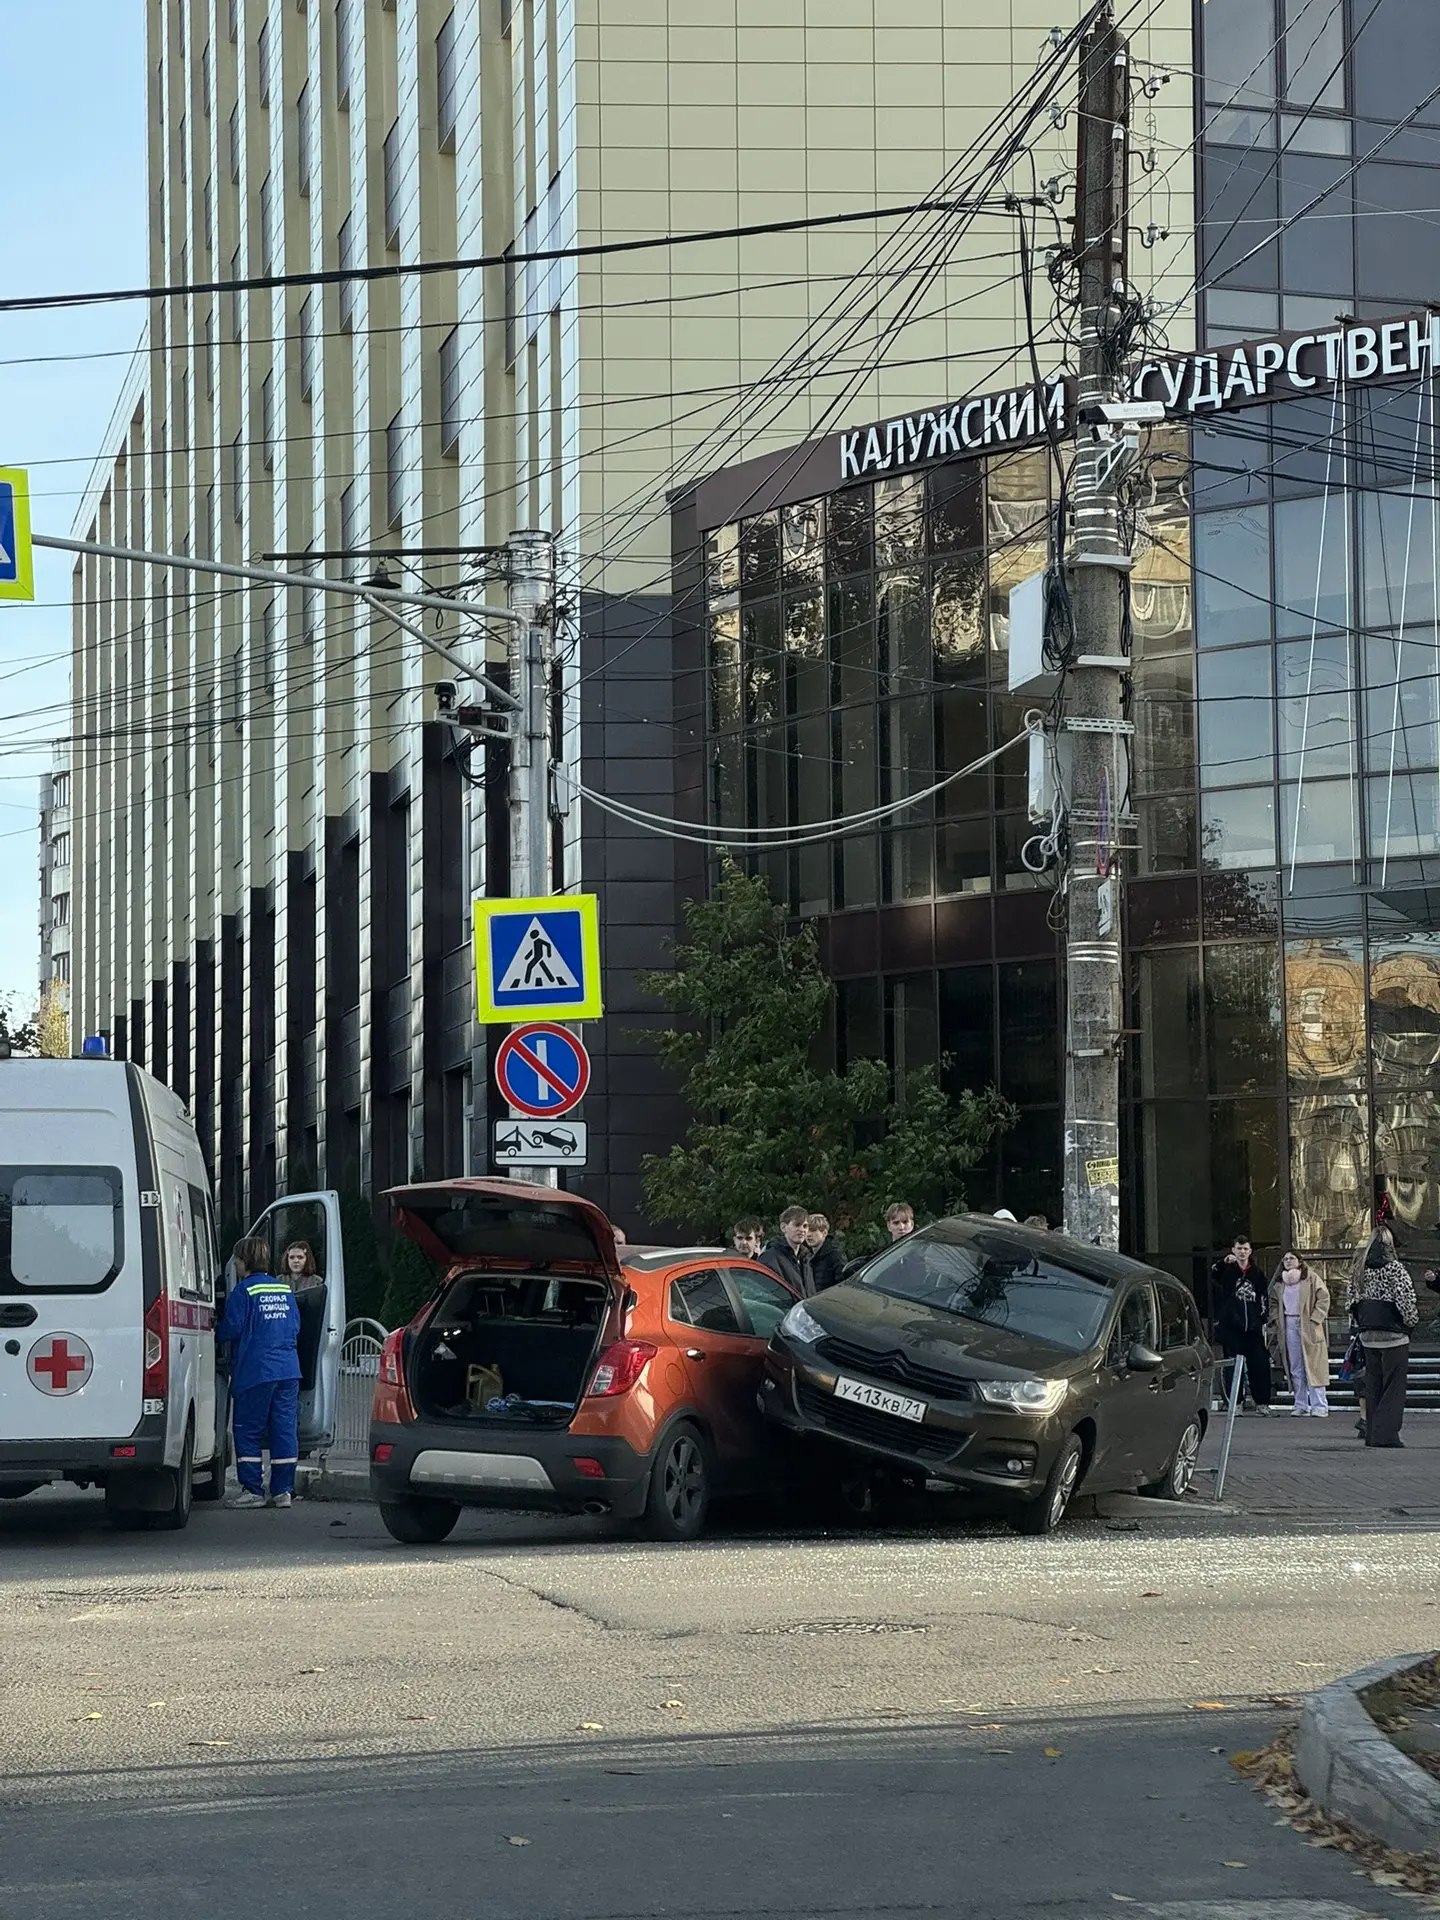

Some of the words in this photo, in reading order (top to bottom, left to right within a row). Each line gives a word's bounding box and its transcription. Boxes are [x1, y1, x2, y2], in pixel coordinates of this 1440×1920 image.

[840, 374, 1065, 479] КАЛУЖСКИЙ
[1123, 315, 1440, 411] СУДАРСТВЕН
[260, 1295, 287, 1303] СКОРАЯ
[259, 1303, 290, 1312] ПОМОЩЬ
[264, 1312, 287, 1320] КАЛУГА
[905, 1400, 921, 1415] 71
